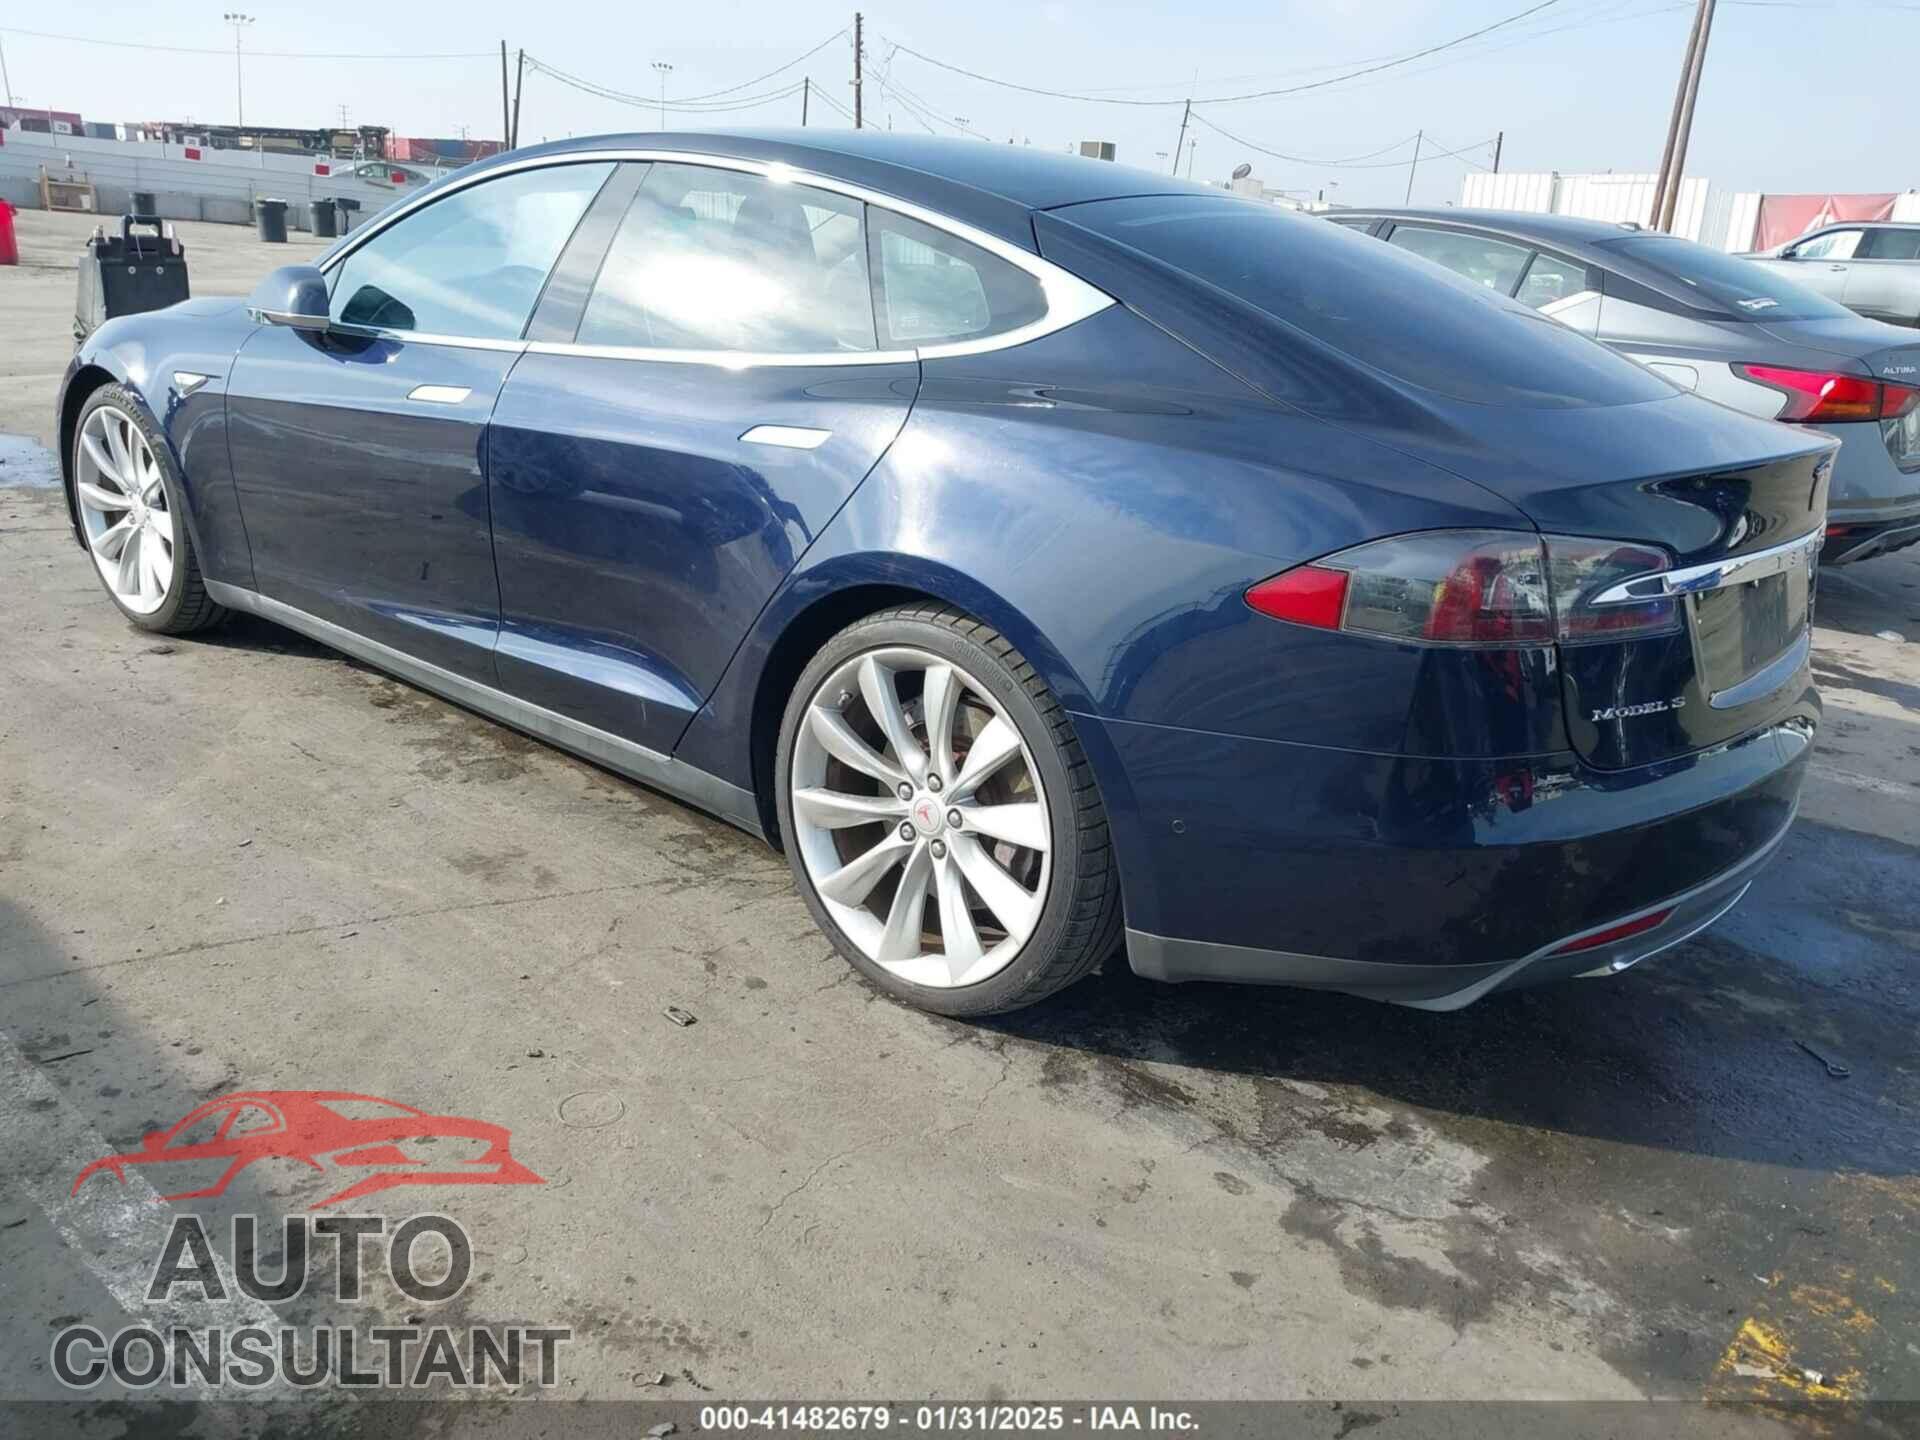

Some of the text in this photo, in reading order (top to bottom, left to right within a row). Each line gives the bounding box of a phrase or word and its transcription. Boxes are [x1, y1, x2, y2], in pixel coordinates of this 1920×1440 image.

[1882, 365, 1917, 376] ALTIMA
[1591, 696, 1687, 722] MODEL S
